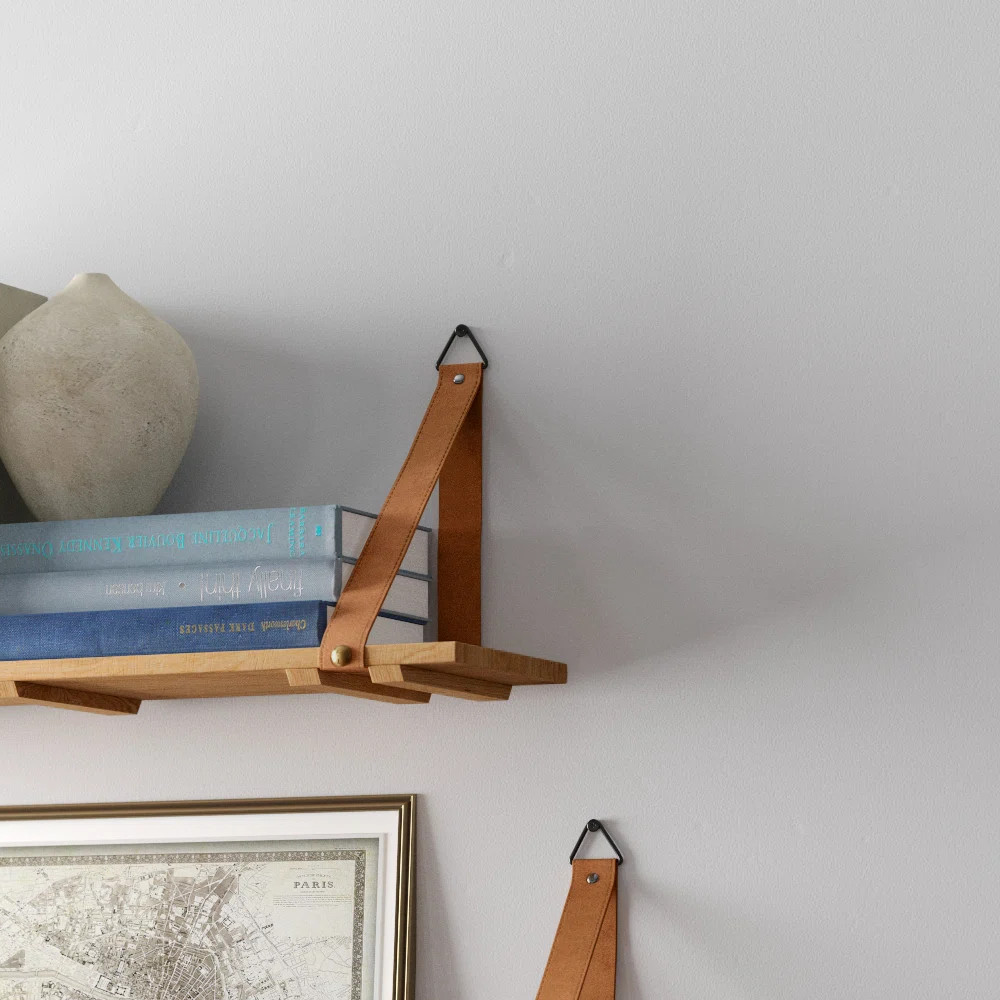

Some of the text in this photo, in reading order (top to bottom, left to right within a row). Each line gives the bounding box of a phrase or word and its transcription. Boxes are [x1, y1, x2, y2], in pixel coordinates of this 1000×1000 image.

[127, 532, 186, 551] BOUVIER
[191, 523, 274, 546] JACQUELINE
[0, 540, 54, 560] ONASSIS
[58, 537, 122, 555] KENNEDY
[248, 565, 304, 599] finally
[179, 623, 225, 635] PASSAGES
[228, 622, 255, 632] DARK
